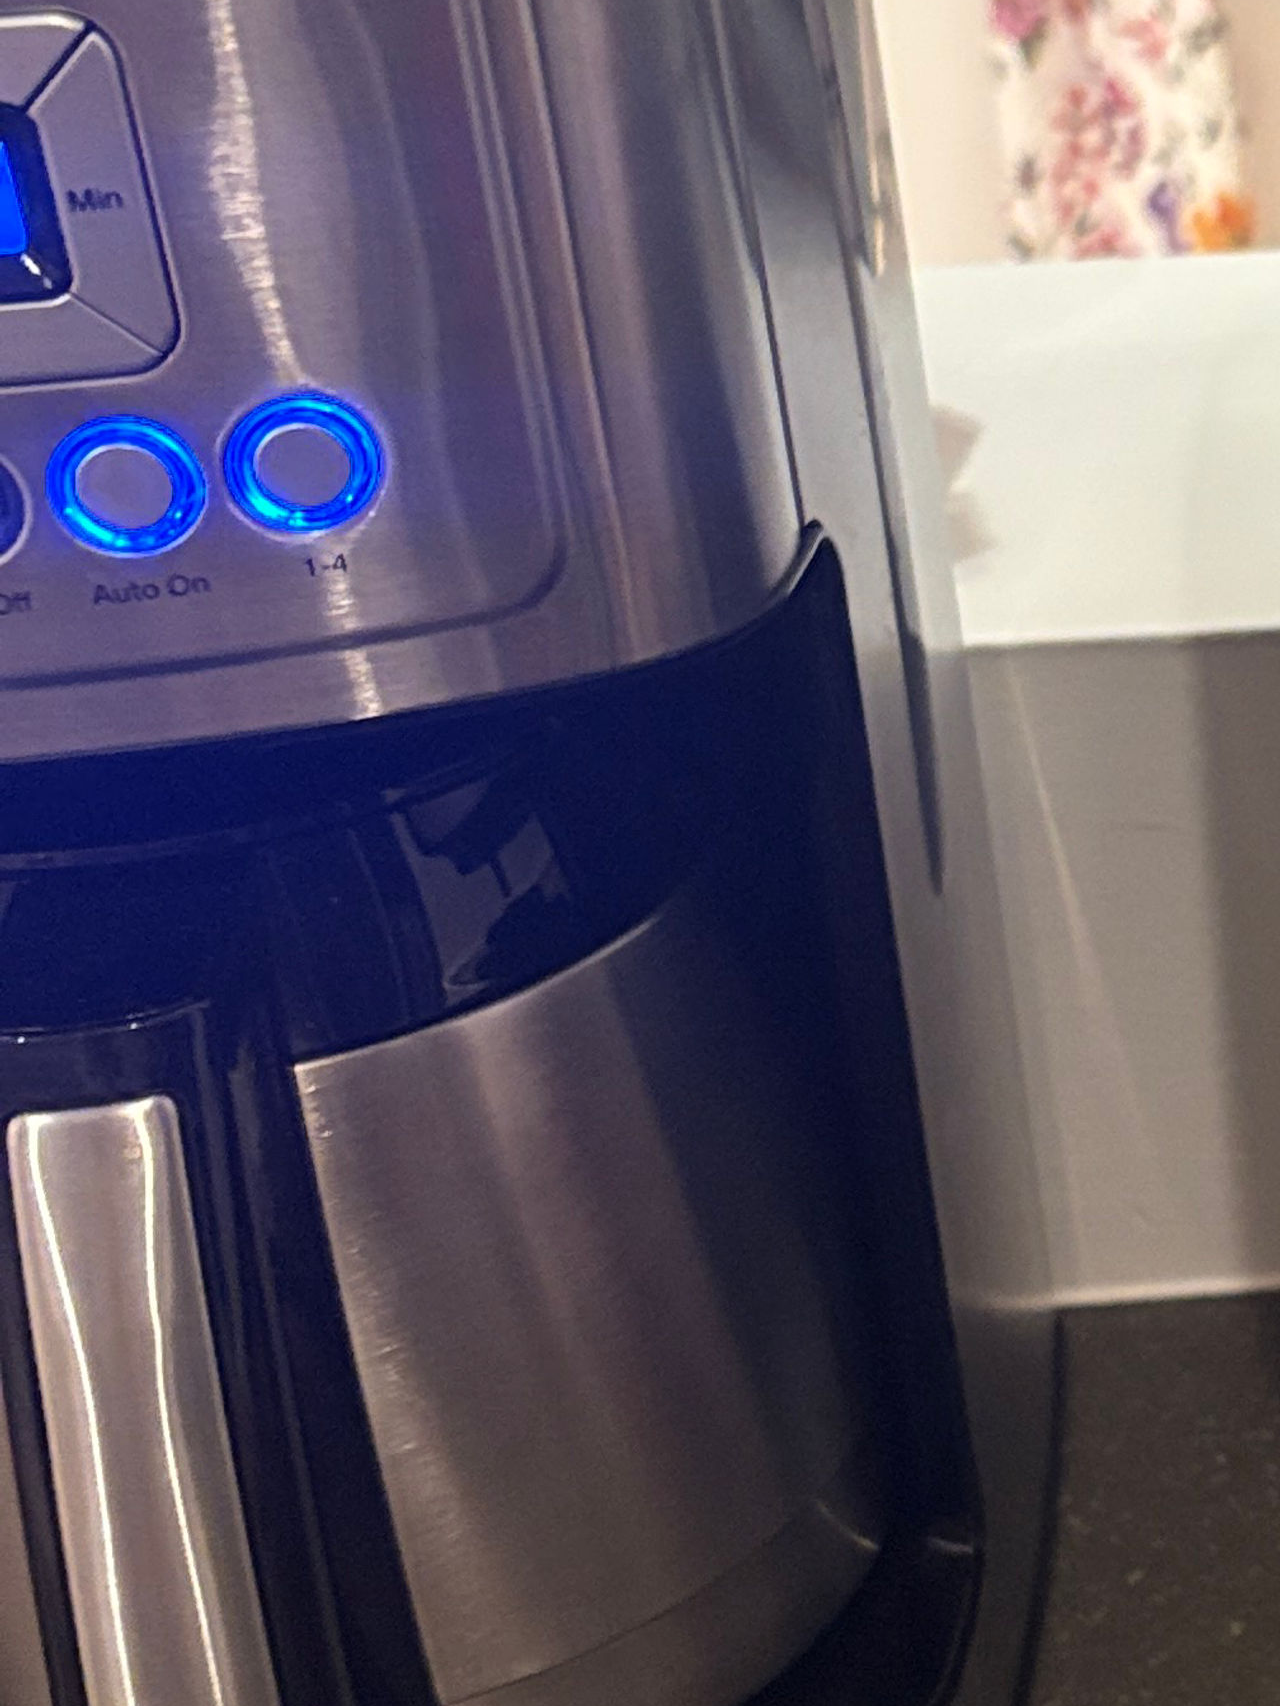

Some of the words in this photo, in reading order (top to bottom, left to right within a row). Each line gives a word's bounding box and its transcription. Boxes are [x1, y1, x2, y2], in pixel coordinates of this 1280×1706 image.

[66, 188, 123, 212] Min
[305, 554, 348, 577] 1-4
[94, 581, 161, 606] Auto
[166, 573, 211, 597] On
